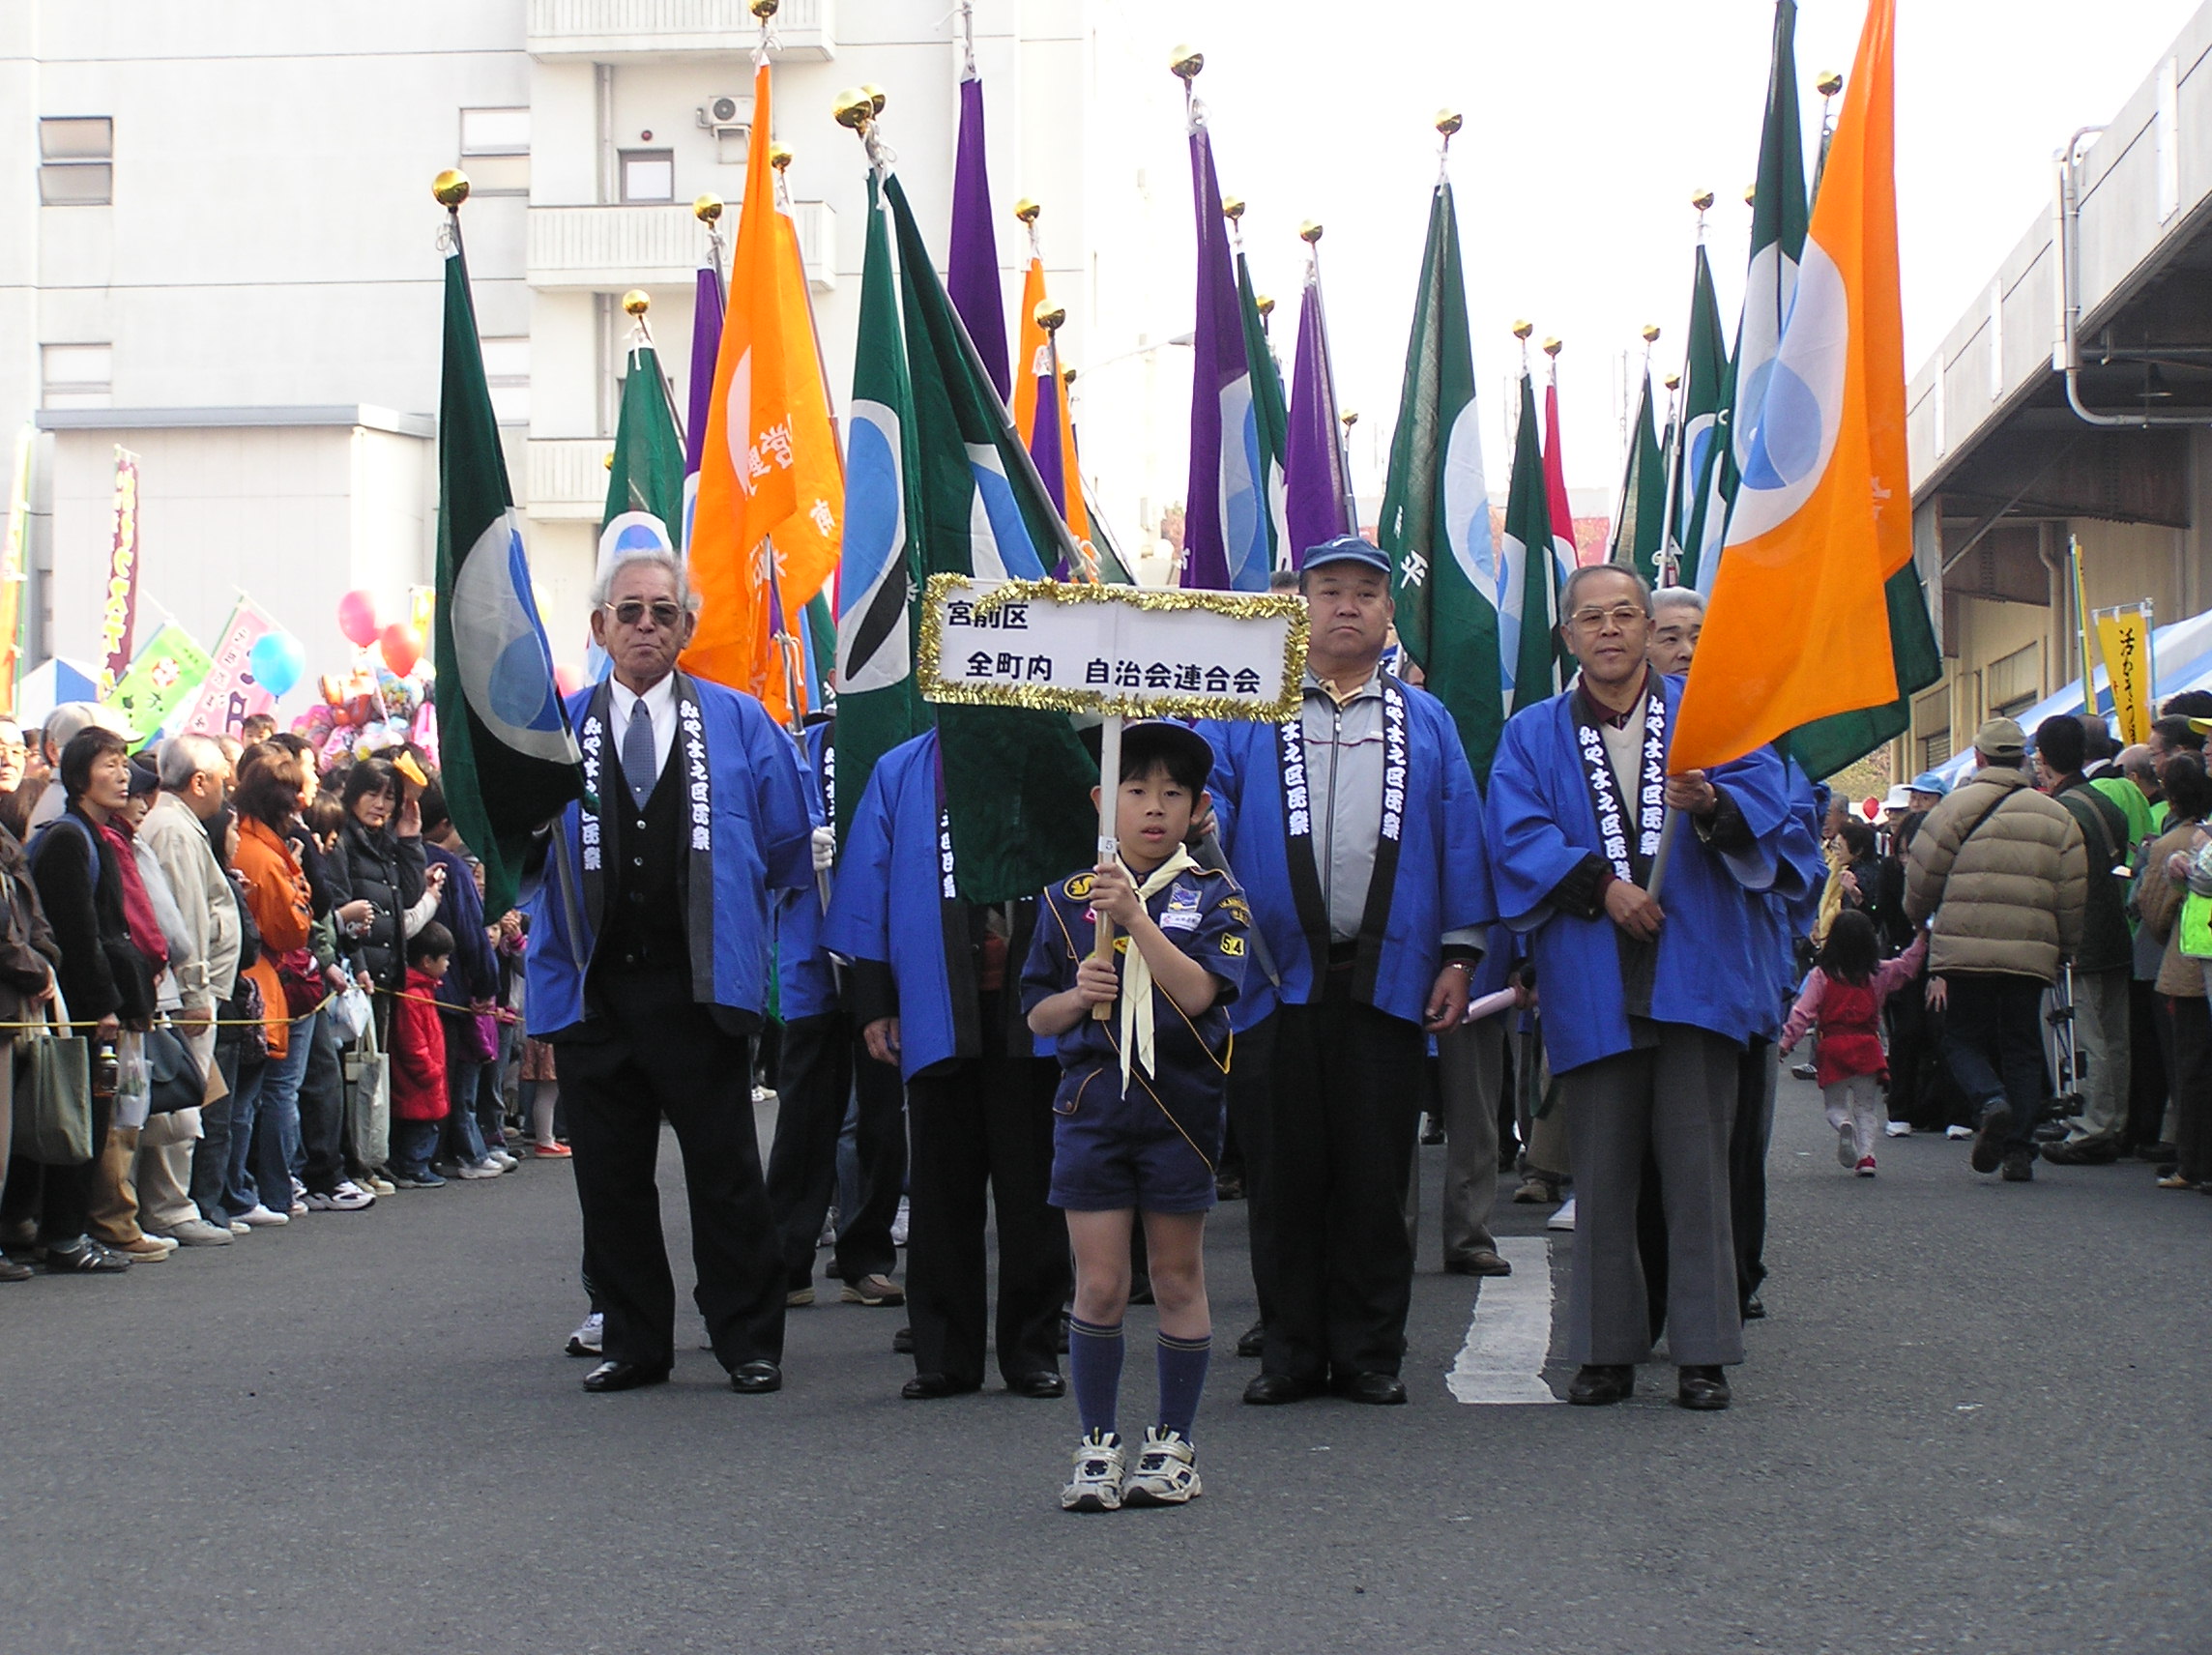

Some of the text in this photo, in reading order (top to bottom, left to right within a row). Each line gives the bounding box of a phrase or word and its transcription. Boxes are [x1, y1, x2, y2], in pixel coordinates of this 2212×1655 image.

[947, 599, 1029, 630] 宮前区
[965, 651, 1261, 694] 全町内 自治会連合会
[680, 699, 712, 852] みやまえ区民祭
[1382, 688, 1407, 841] みやまえ区民祭
[1579, 726, 1633, 884] みやまえ区民祭
[1640, 695, 1666, 857] みやまえ区民祭
[1222, 935, 1243, 954] 54
